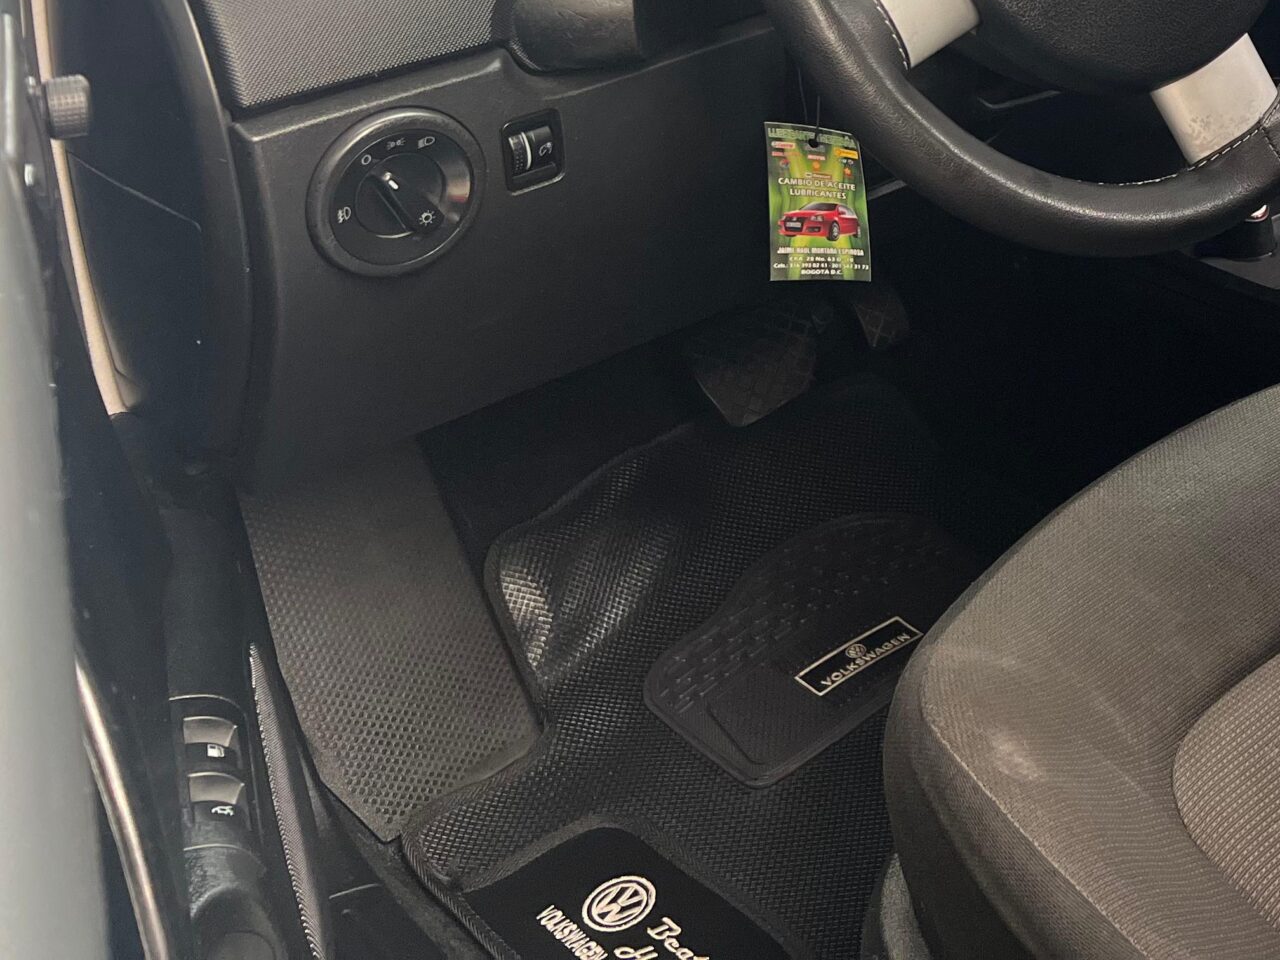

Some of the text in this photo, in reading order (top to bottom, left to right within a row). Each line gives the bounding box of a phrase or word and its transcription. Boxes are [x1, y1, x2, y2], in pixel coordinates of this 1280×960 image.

[777, 177, 812, 186] CAMBIO
[827, 182, 856, 191] ACEITE
[789, 188, 847, 200] LUBRICANTES
[820, 632, 911, 686] VOLKSWAGEN
